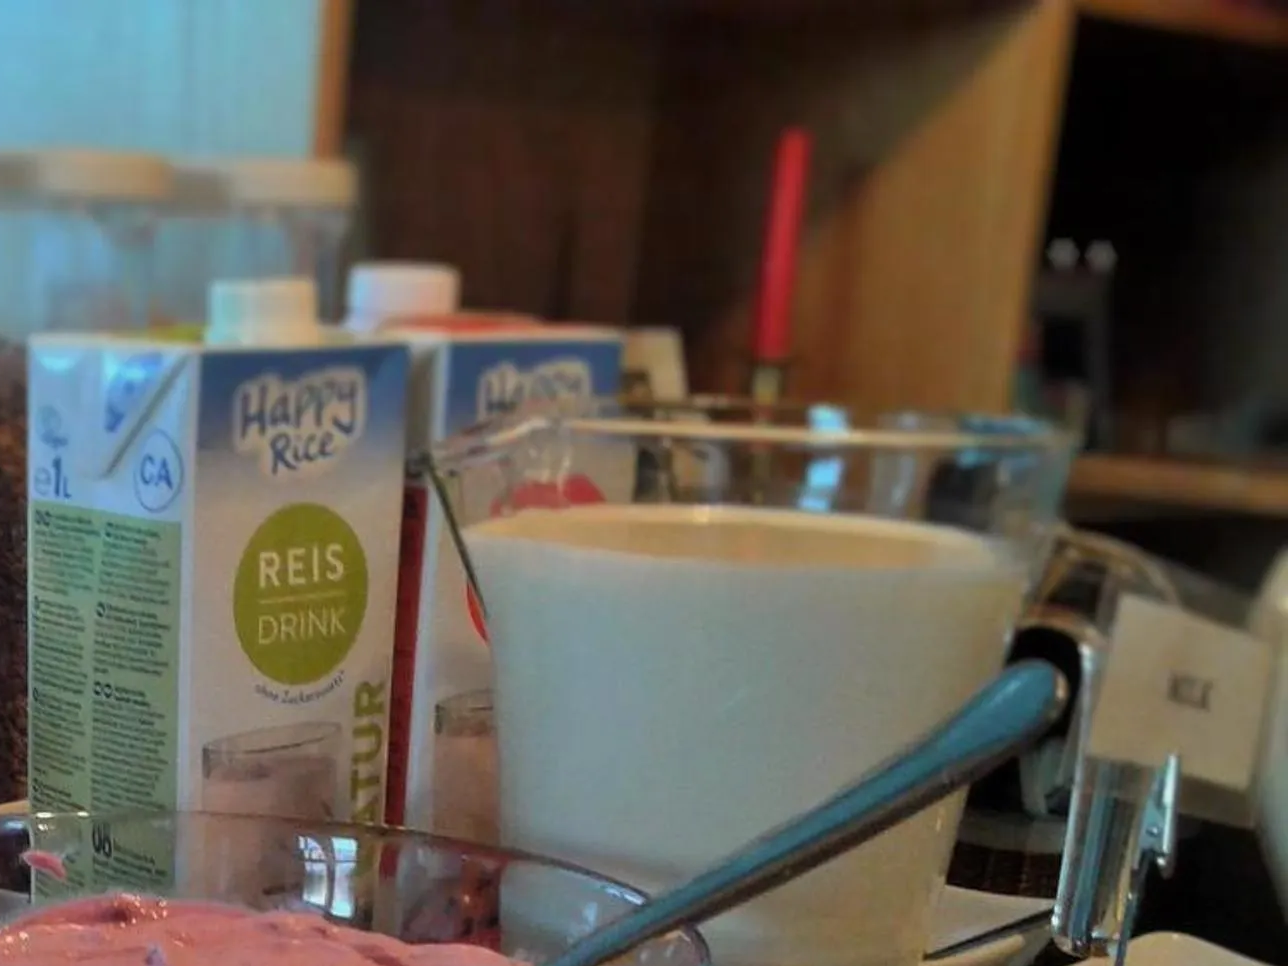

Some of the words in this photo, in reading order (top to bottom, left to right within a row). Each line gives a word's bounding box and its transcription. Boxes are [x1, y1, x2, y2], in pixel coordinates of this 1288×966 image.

[240, 377, 360, 441] Happy
[140, 453, 173, 491] CA
[268, 430, 335, 477] Rice
[258, 542, 345, 590] REIS
[257, 604, 347, 646] DRINK
